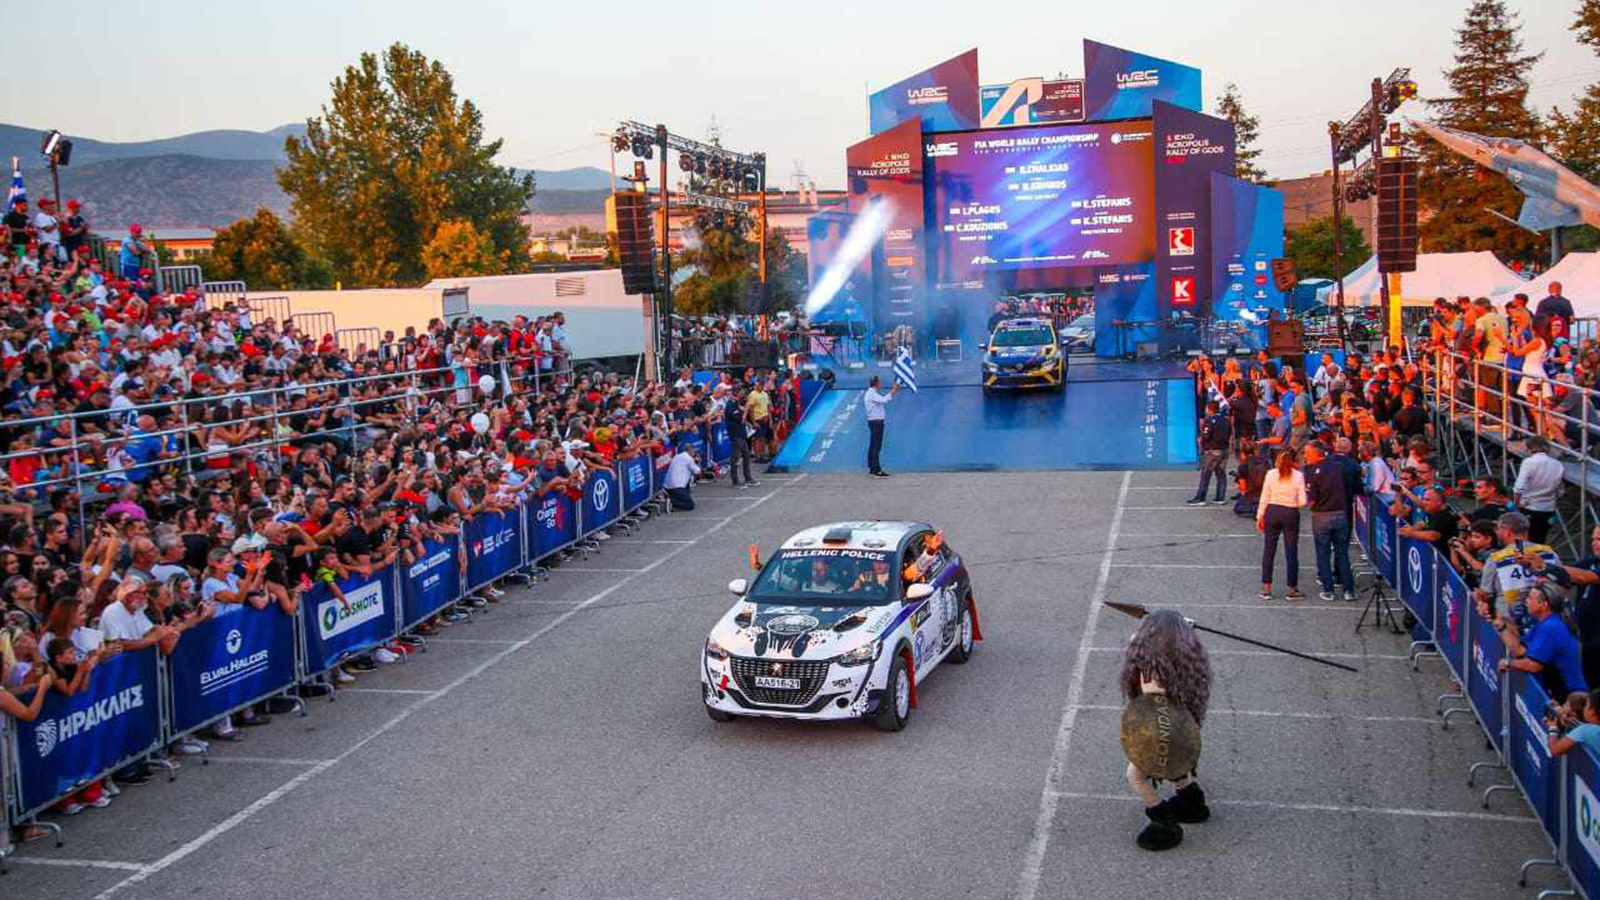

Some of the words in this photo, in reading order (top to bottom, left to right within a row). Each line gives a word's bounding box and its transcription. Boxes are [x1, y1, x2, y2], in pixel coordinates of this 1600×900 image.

[1117, 69, 1159, 82] WRC
[908, 86, 948, 97] WRC
[857, 168, 878, 177] RALLY
[1175, 280, 1191, 298] K
[781, 549, 839, 559] HELLENIC
[841, 550, 887, 561] POLICE
[60, 684, 144, 742] ΗΡΑΚΛΗΣ
